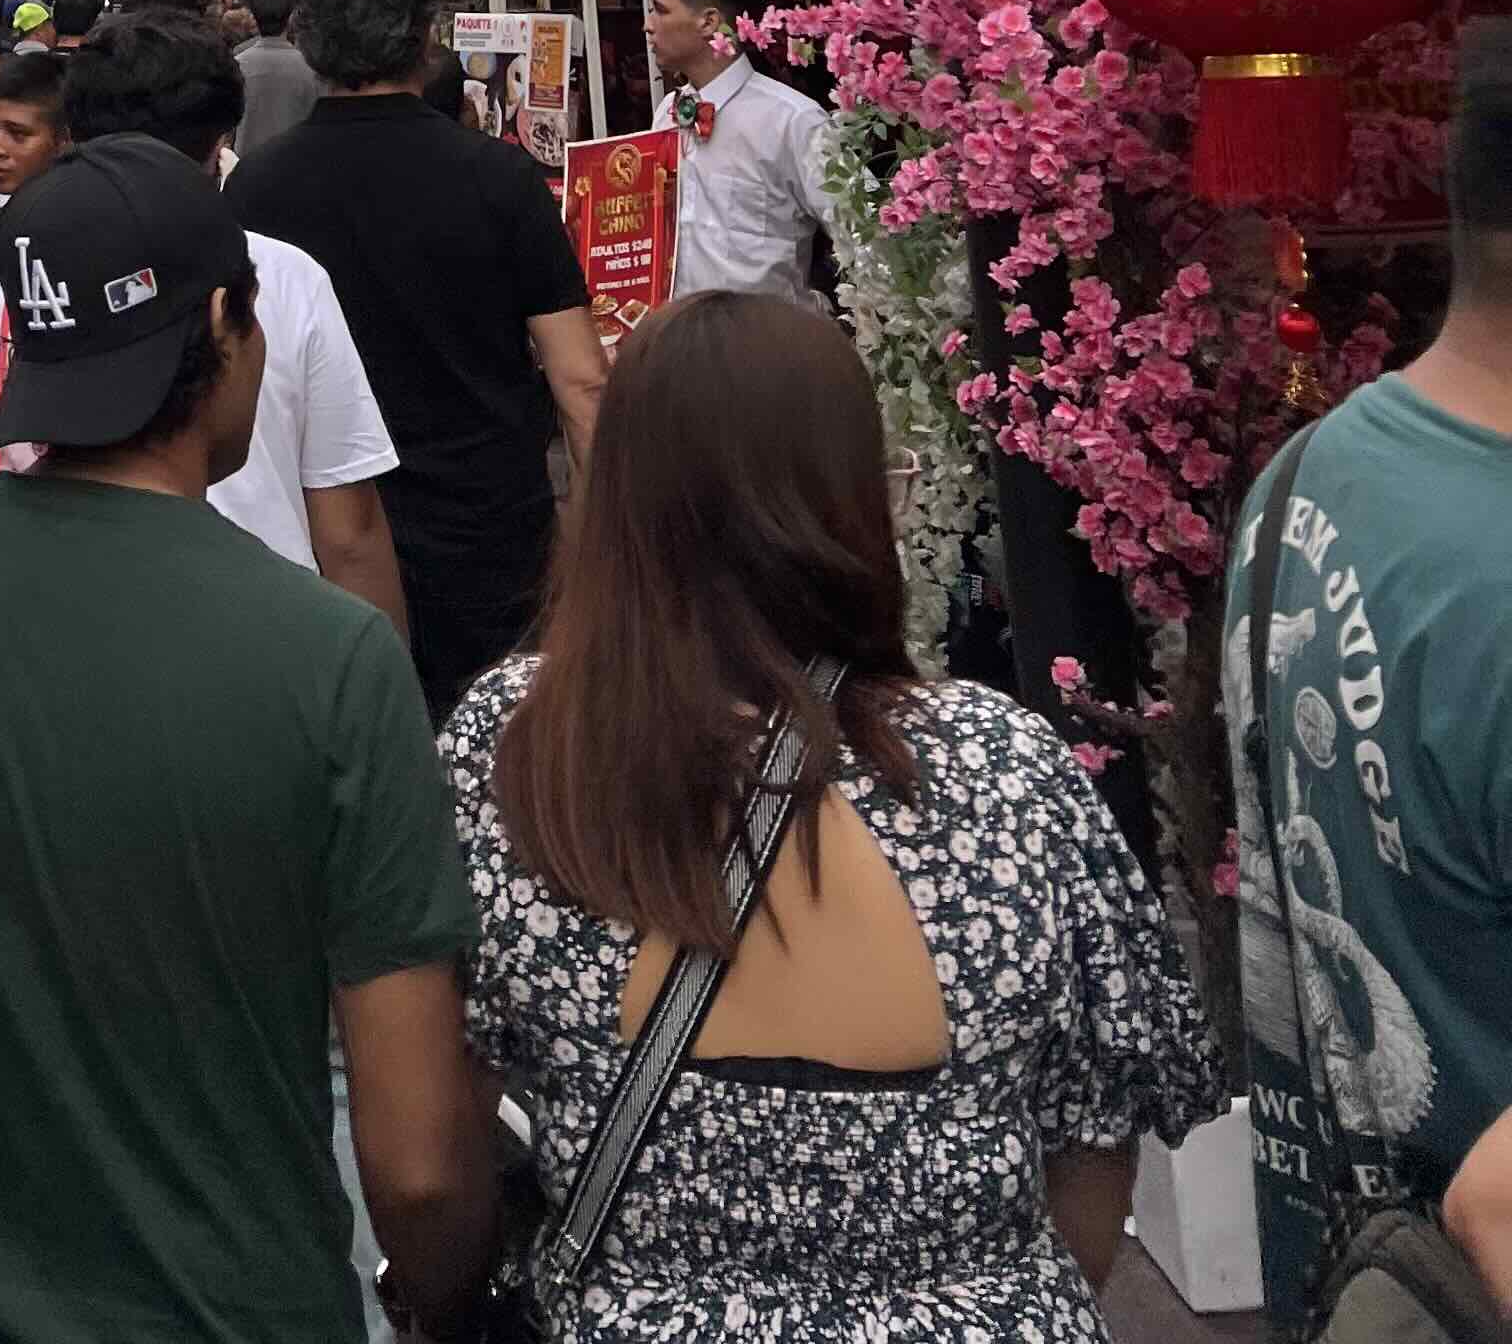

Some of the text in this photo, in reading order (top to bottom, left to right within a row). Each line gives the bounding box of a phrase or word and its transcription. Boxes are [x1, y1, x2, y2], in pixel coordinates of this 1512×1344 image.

[456, 17, 492, 31] PAQUETE
[599, 213, 644, 235] CHINO
[14, 236, 77, 331] LA
[1324, 565, 1411, 875] JUDGE
